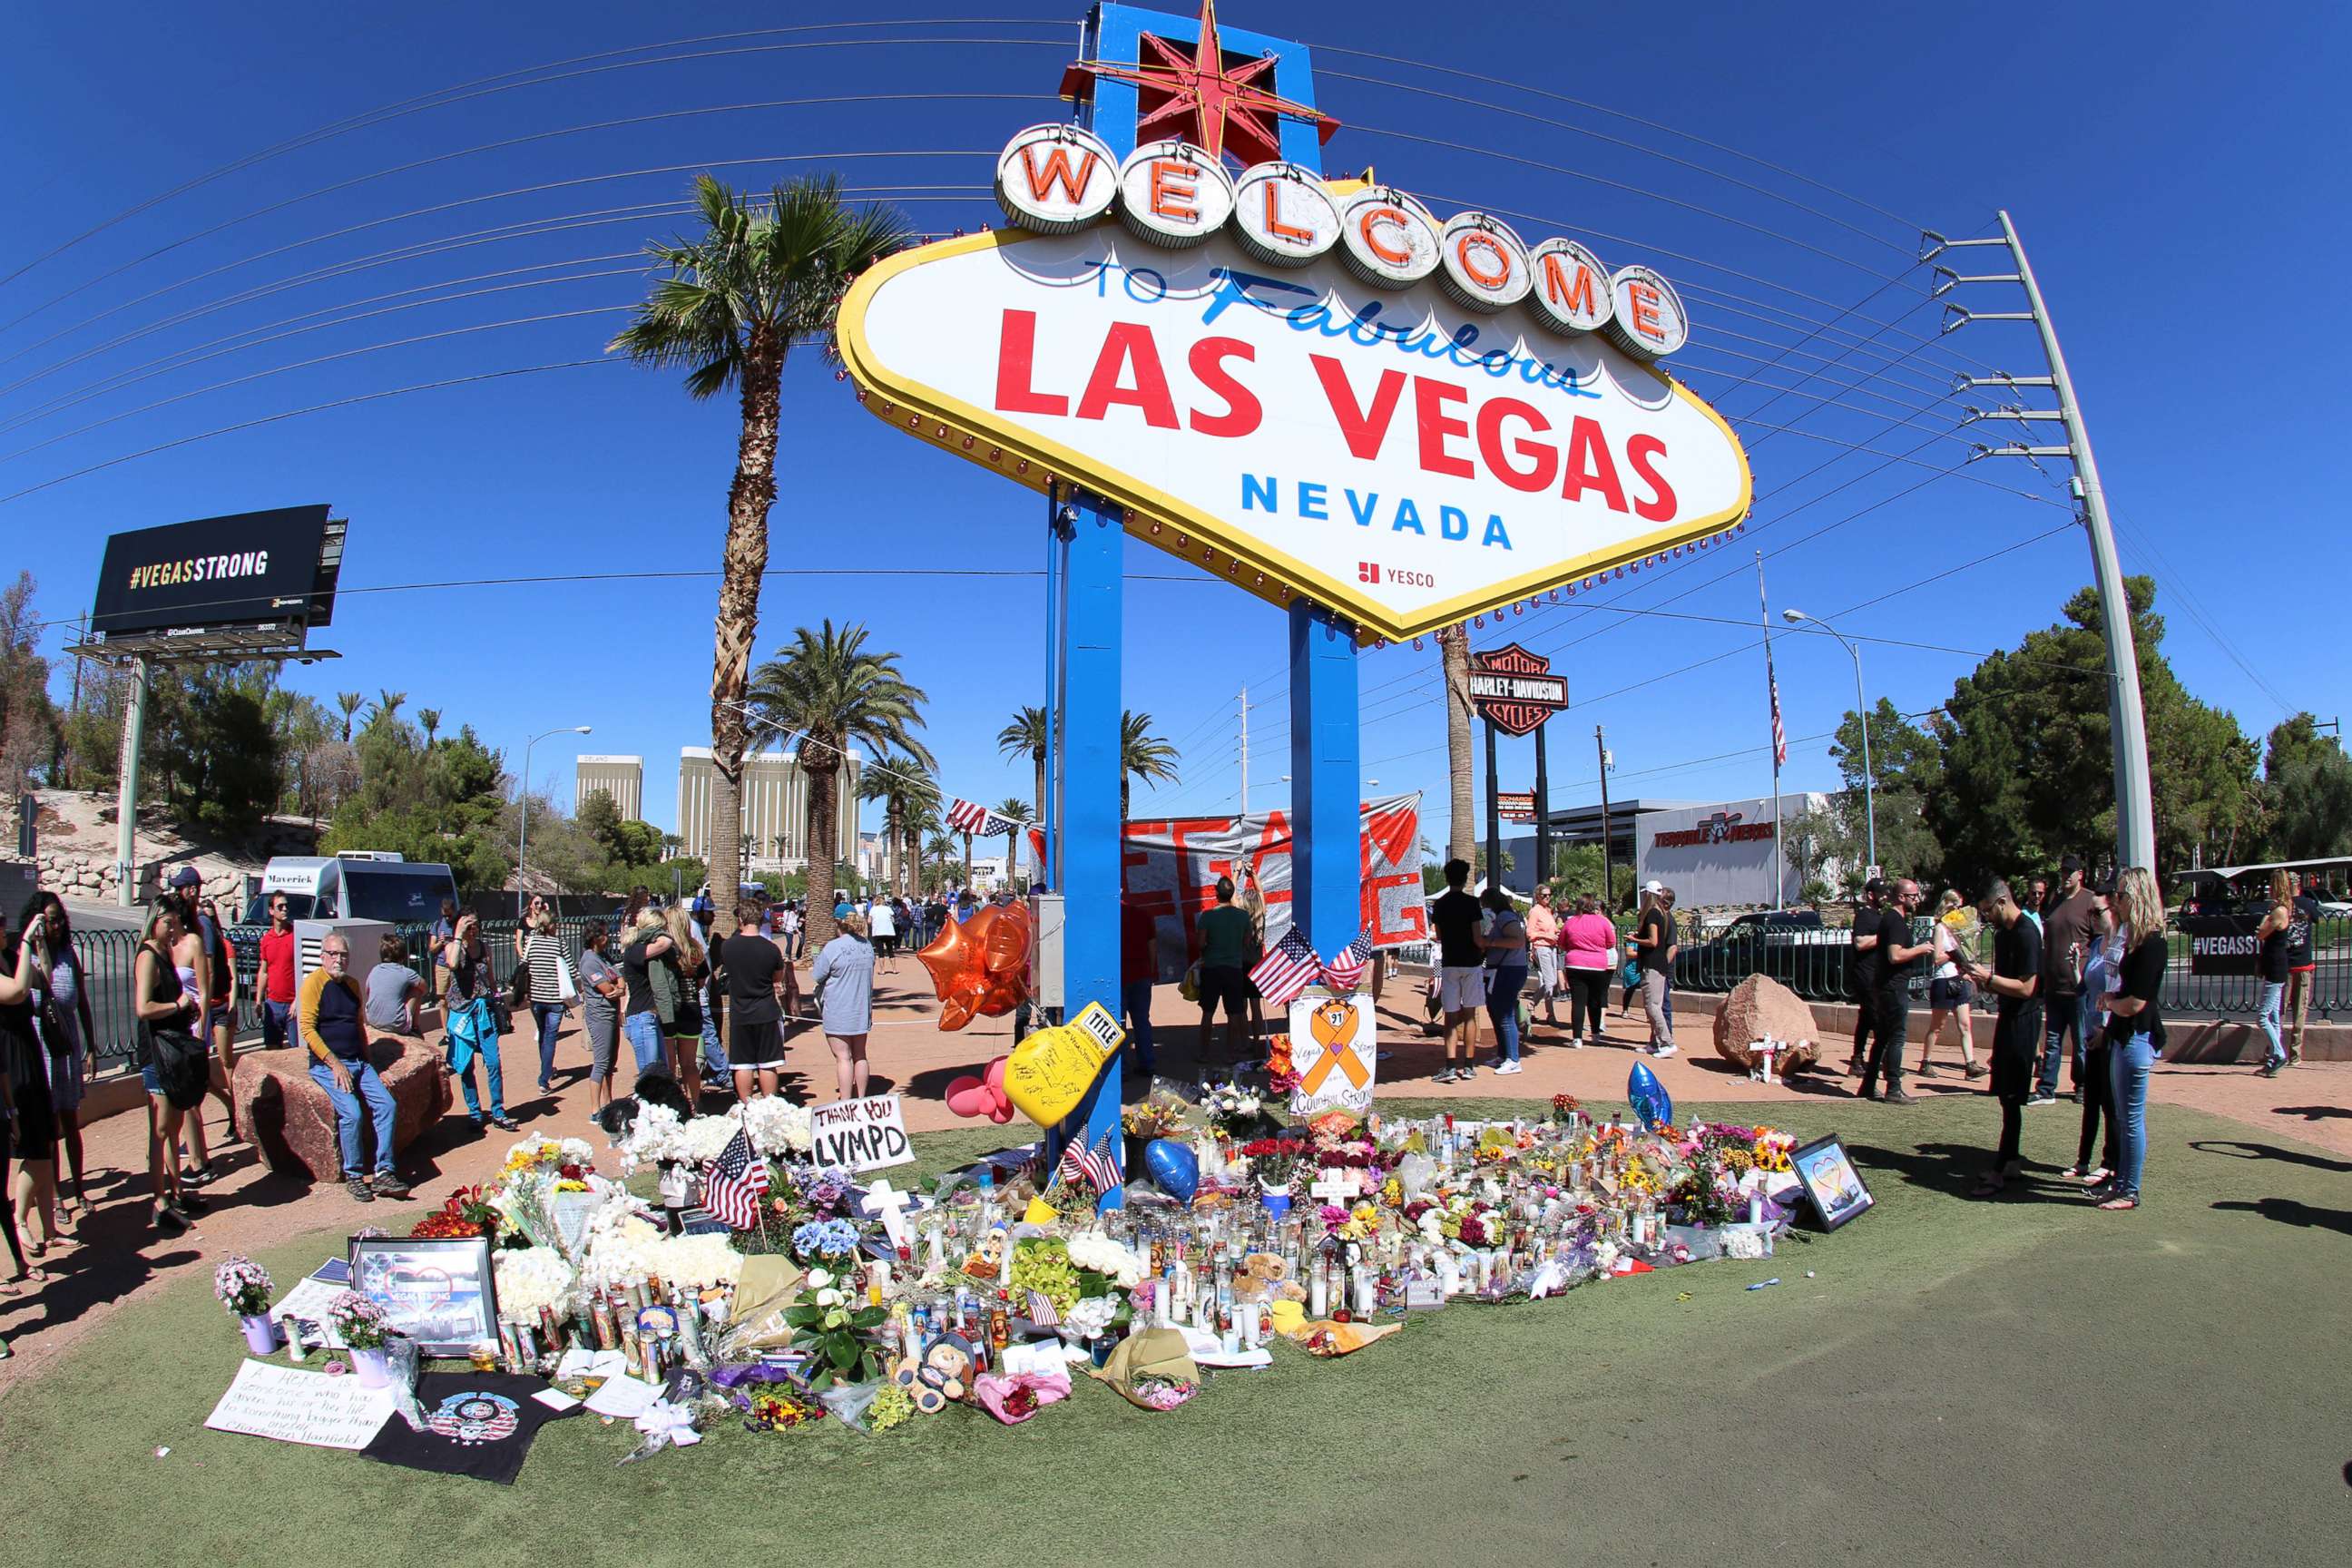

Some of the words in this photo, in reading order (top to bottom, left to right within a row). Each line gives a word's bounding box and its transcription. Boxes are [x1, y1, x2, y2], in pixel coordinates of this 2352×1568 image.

[1019, 144, 1664, 344] WELCOME
[1084, 260, 1166, 304] TO
[1210, 266, 1602, 400] Fabulous
[995, 308, 1263, 438] LAS
[1308, 353, 1678, 524] VEGAS
[1241, 473, 1514, 551] NEVADA
[130, 551, 269, 590] #VEGASSTRONG
[1387, 568, 1436, 588] YESCO
[1492, 653, 1543, 674] MOTOR
[1470, 676, 1563, 701] HARLEY-DAVIDSON
[1492, 703, 1544, 729] CYCLES
[269, 874, 312, 884] Maverick
[1089, 1012, 1117, 1044] TITLE
[1330, 1013, 1342, 1024] 91
[815, 1103, 861, 1127] THANK
[864, 1099, 892, 1121] YOU
[815, 1124, 906, 1168] LVMPD
